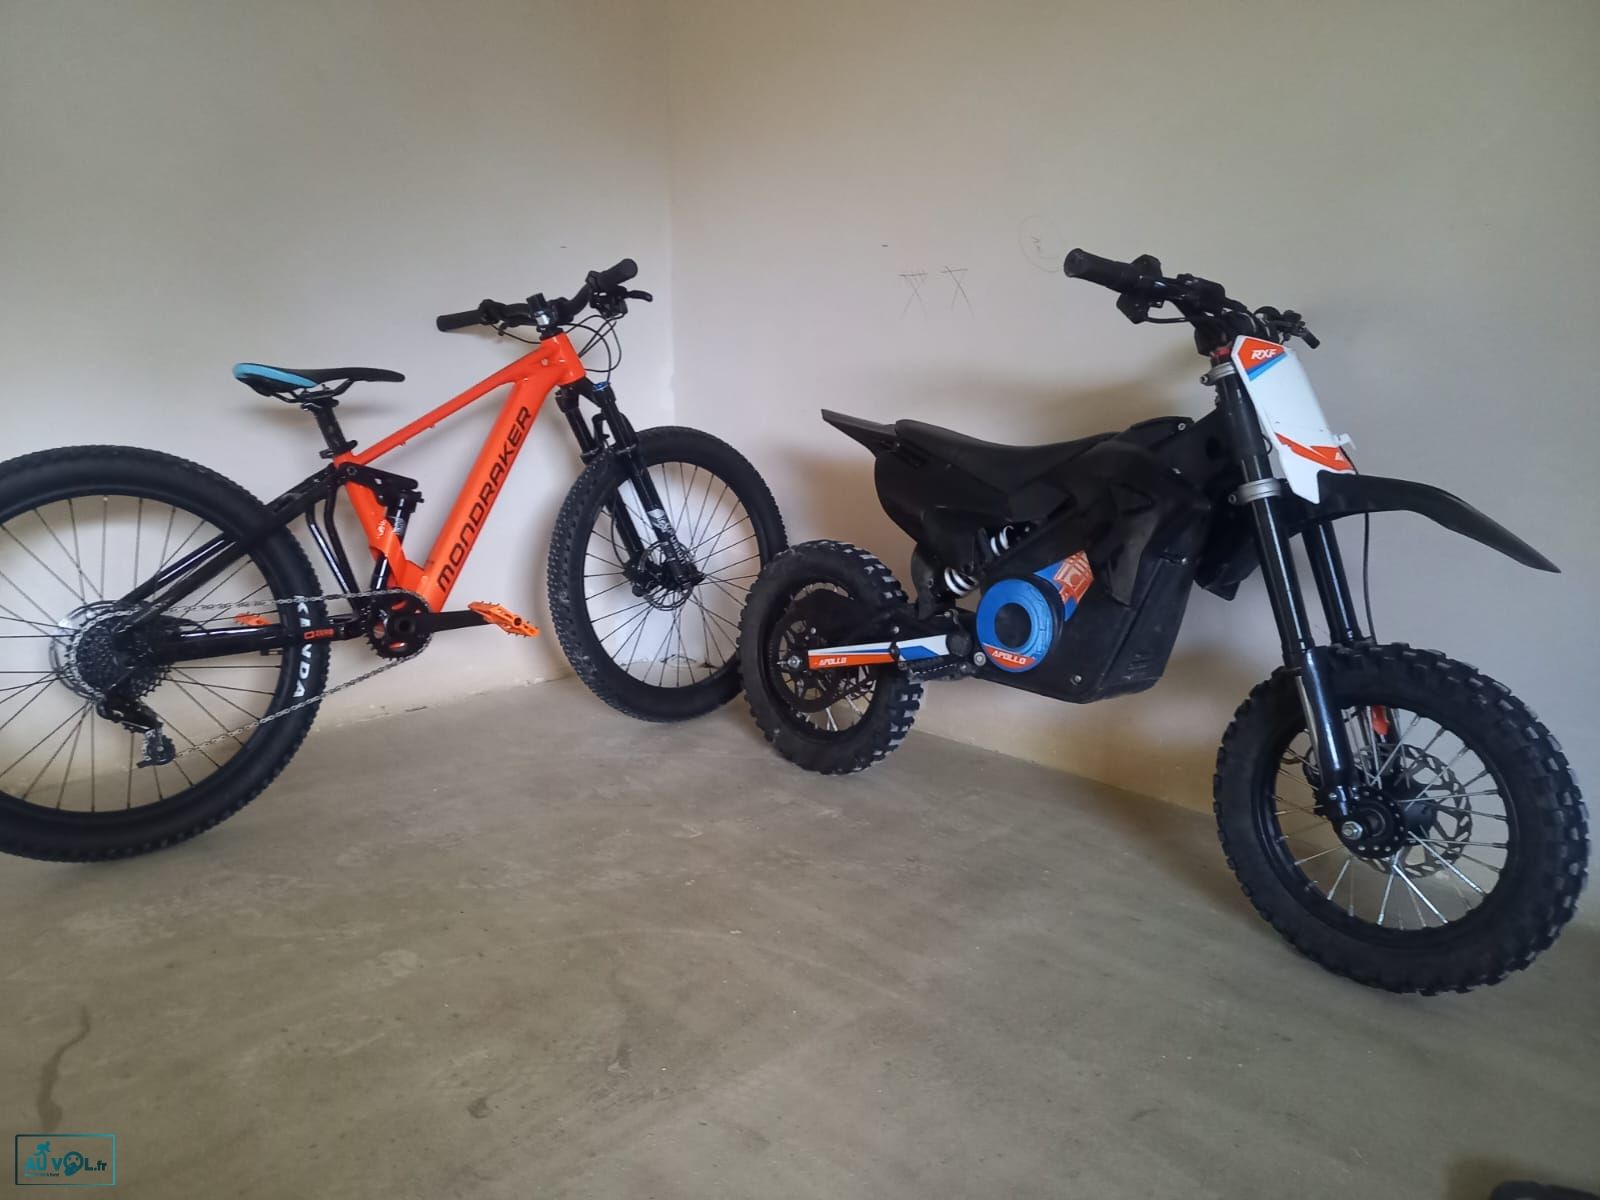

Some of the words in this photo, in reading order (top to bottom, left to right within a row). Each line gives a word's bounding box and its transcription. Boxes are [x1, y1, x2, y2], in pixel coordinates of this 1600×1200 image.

[1251, 348, 1277, 360] RXF
[437, 406, 532, 592] MONDRAKER
[818, 656, 848, 666] APOLLO
[992, 649, 1026, 665] APOLLO
